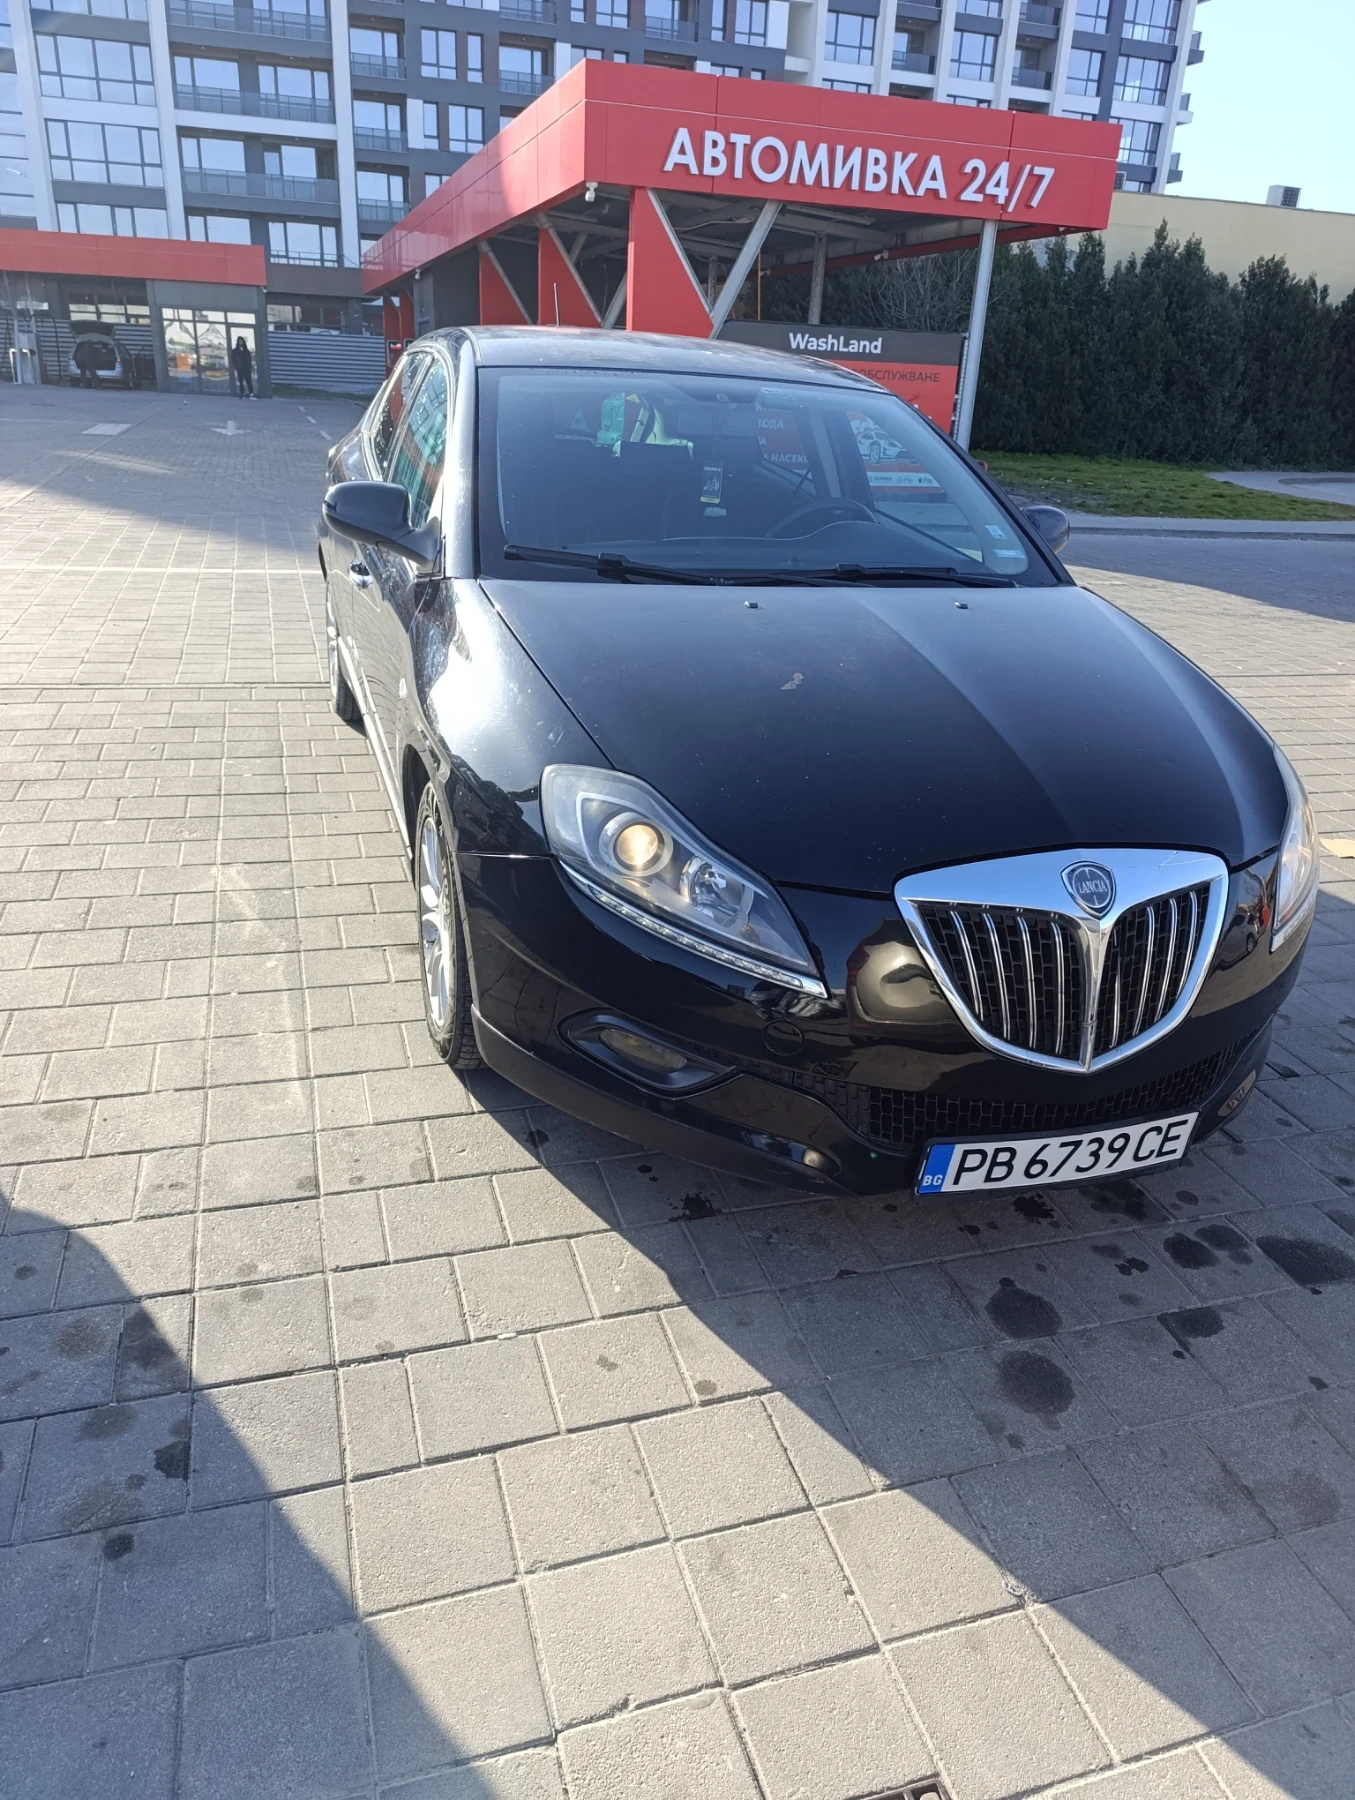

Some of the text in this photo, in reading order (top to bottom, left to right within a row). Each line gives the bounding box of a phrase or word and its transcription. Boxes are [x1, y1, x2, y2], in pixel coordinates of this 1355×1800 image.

[663, 127, 1055, 213] АВТОМИВКА 24/7
[788, 332, 883, 354] WashLand
[852, 368, 940, 383] ОБСЛУЖВАНЕ
[1077, 880, 1107, 894] LANCIA
[922, 1119, 1189, 1186] BG PB 6739 CE
